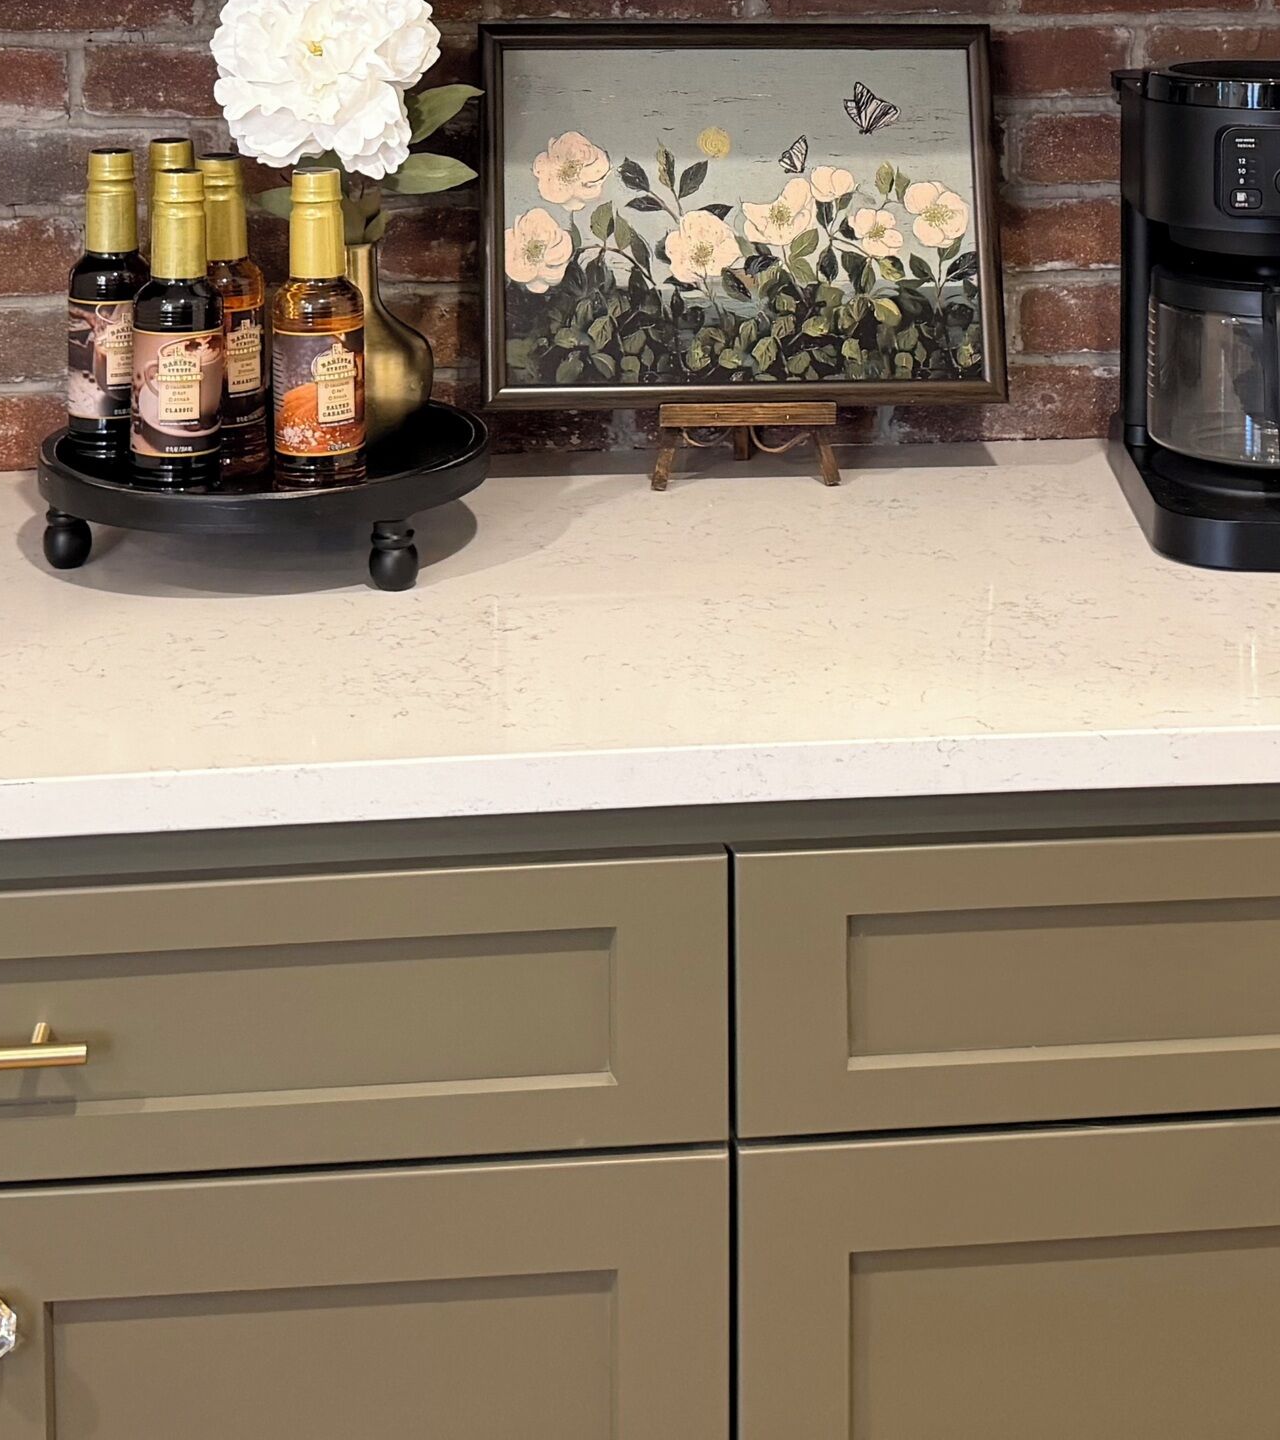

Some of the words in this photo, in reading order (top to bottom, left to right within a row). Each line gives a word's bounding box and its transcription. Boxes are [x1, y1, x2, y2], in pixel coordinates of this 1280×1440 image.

[231, 333, 259, 345] BARISTA
[163, 360, 197, 368] BARISTA
[321, 358, 352, 368] BARISTA
